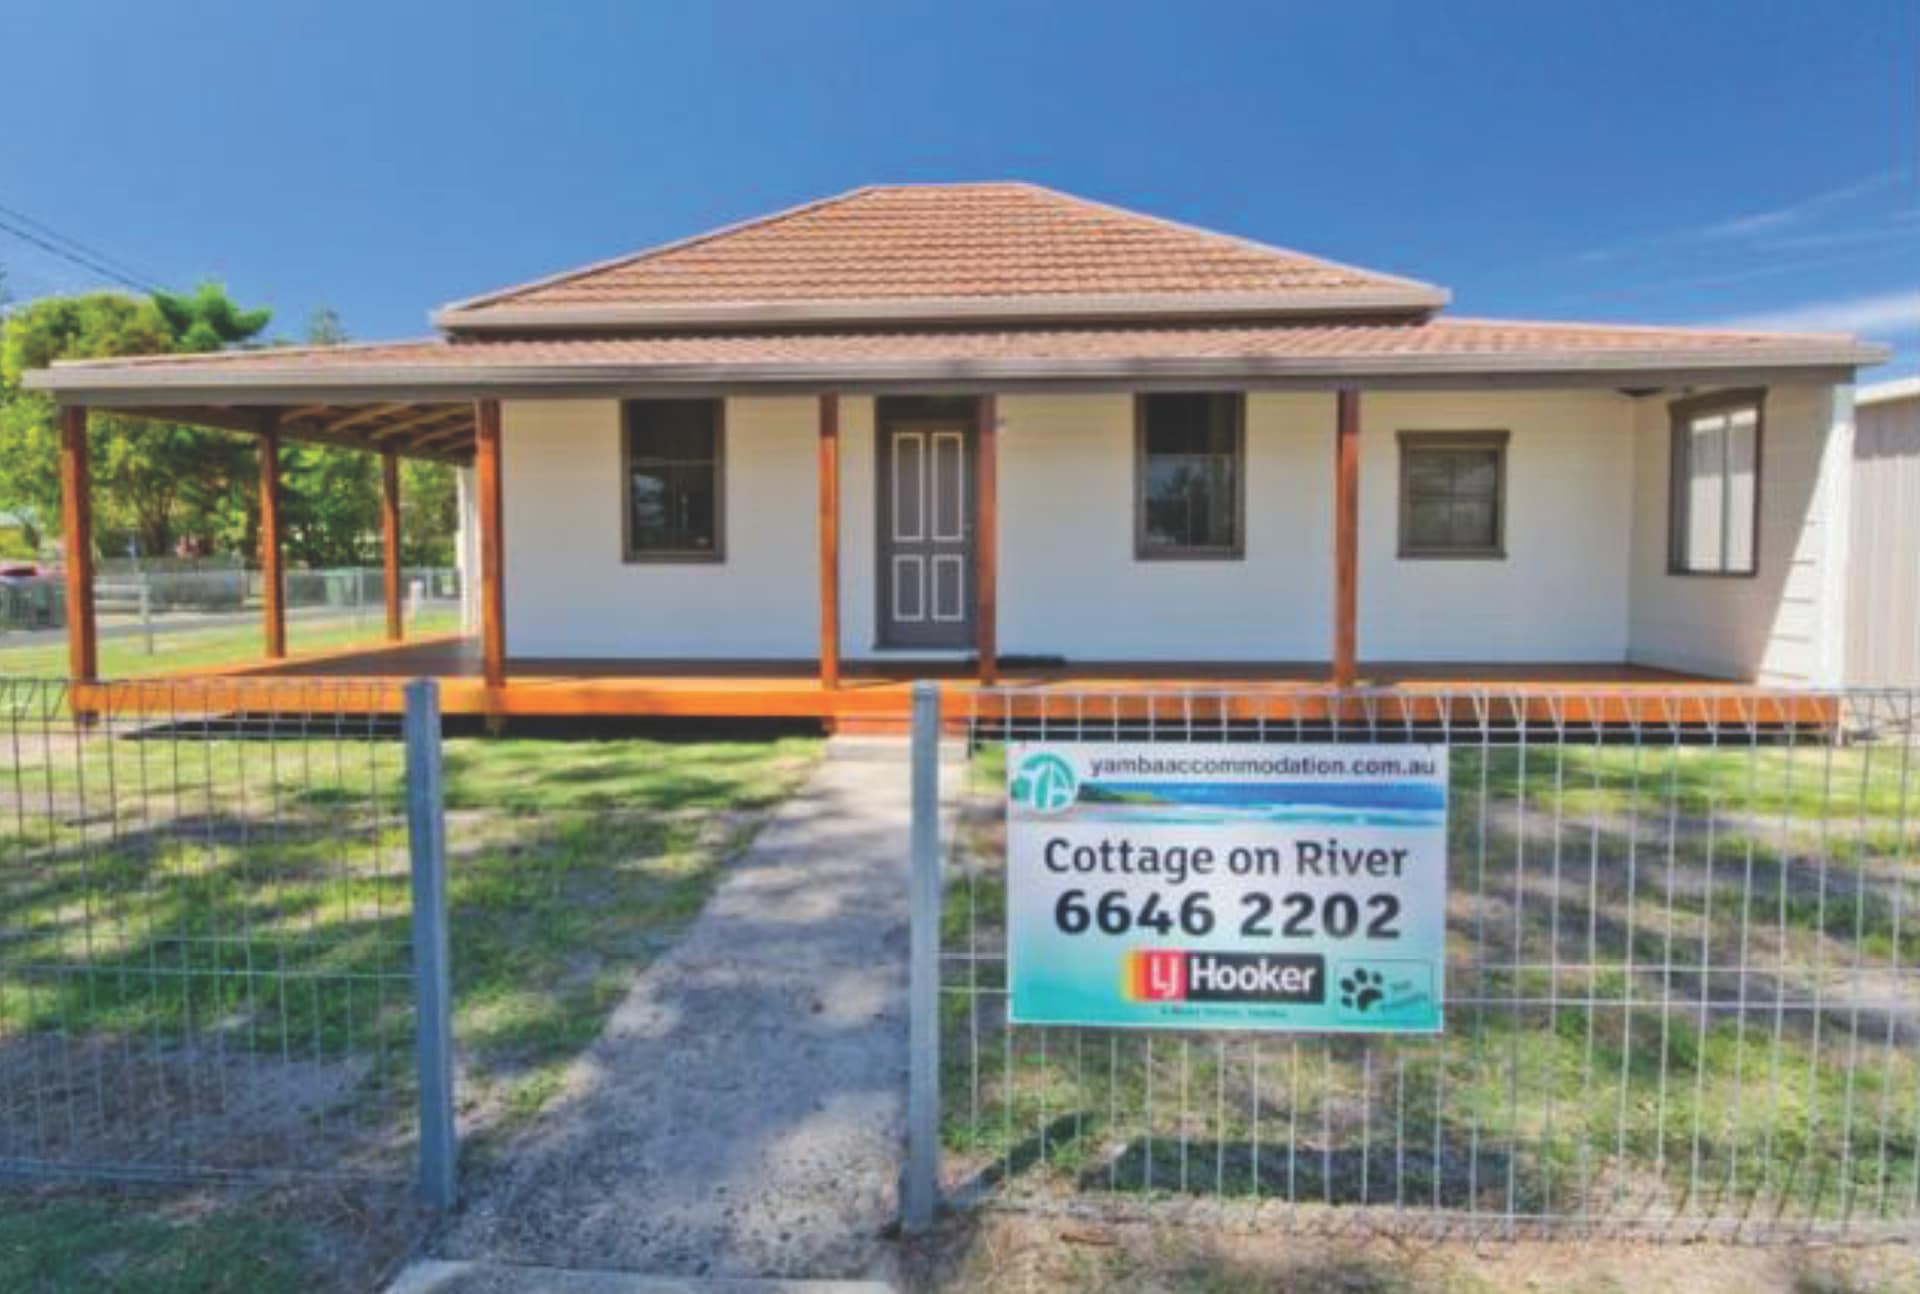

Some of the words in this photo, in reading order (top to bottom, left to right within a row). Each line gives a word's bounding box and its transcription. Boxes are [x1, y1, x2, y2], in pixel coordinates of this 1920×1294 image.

[1090, 756, 1436, 777] yambaaccommodation.com.au
[1044, 837, 1216, 883] Cottage
[1228, 852, 1280, 876] on
[1296, 839, 1409, 876] River
[1054, 890, 1216, 936] 6646
[1239, 893, 1401, 939] 2202
[1190, 957, 1317, 991] Hooker
